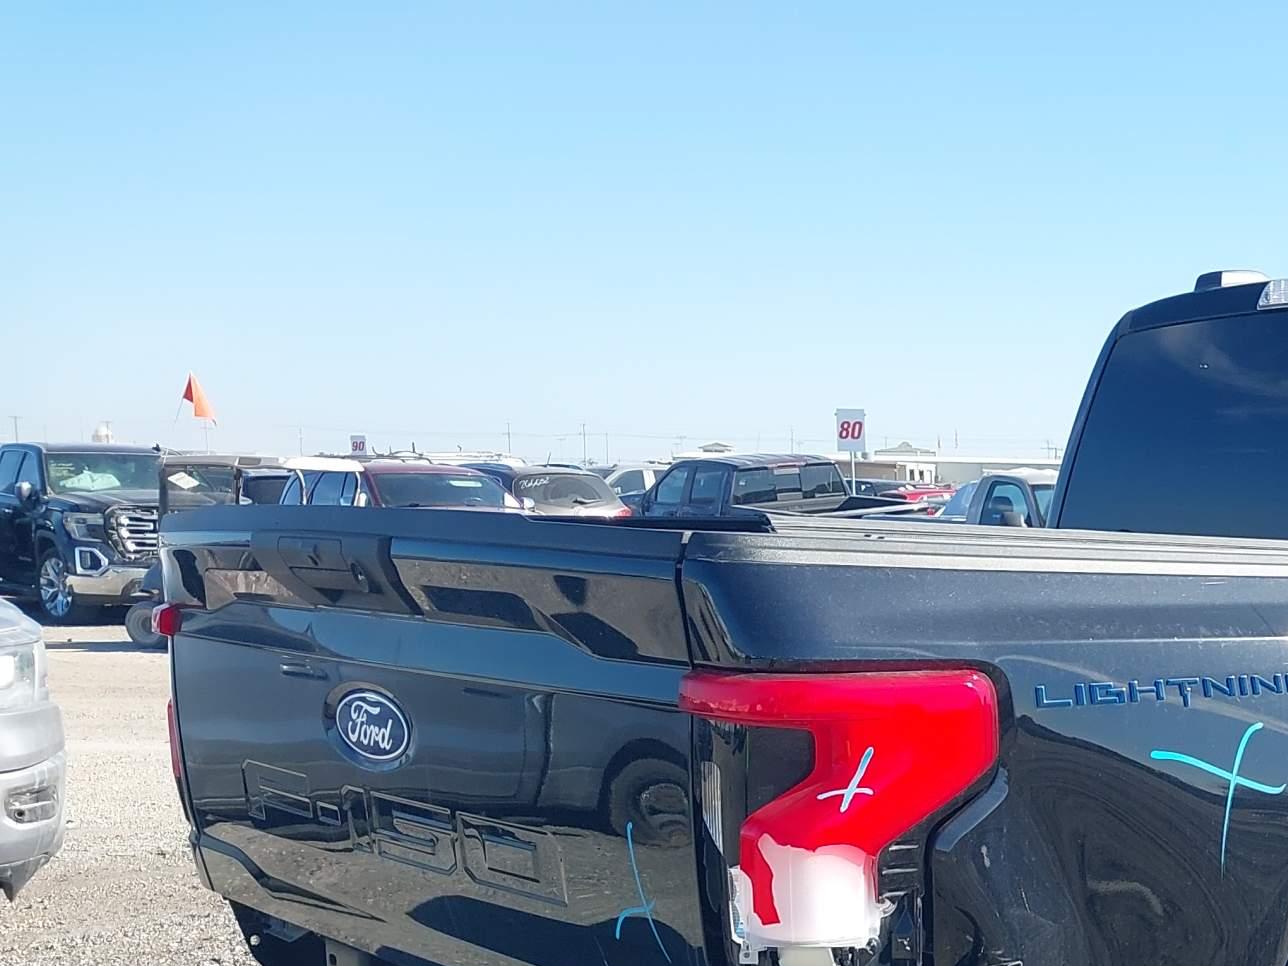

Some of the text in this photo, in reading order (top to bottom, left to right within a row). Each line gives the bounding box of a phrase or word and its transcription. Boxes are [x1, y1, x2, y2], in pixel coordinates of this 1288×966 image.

[352, 441, 365, 451] 90
[839, 421, 862, 439] 80
[348, 701, 393, 750] Ford
[241, 760, 568, 907] F-150
